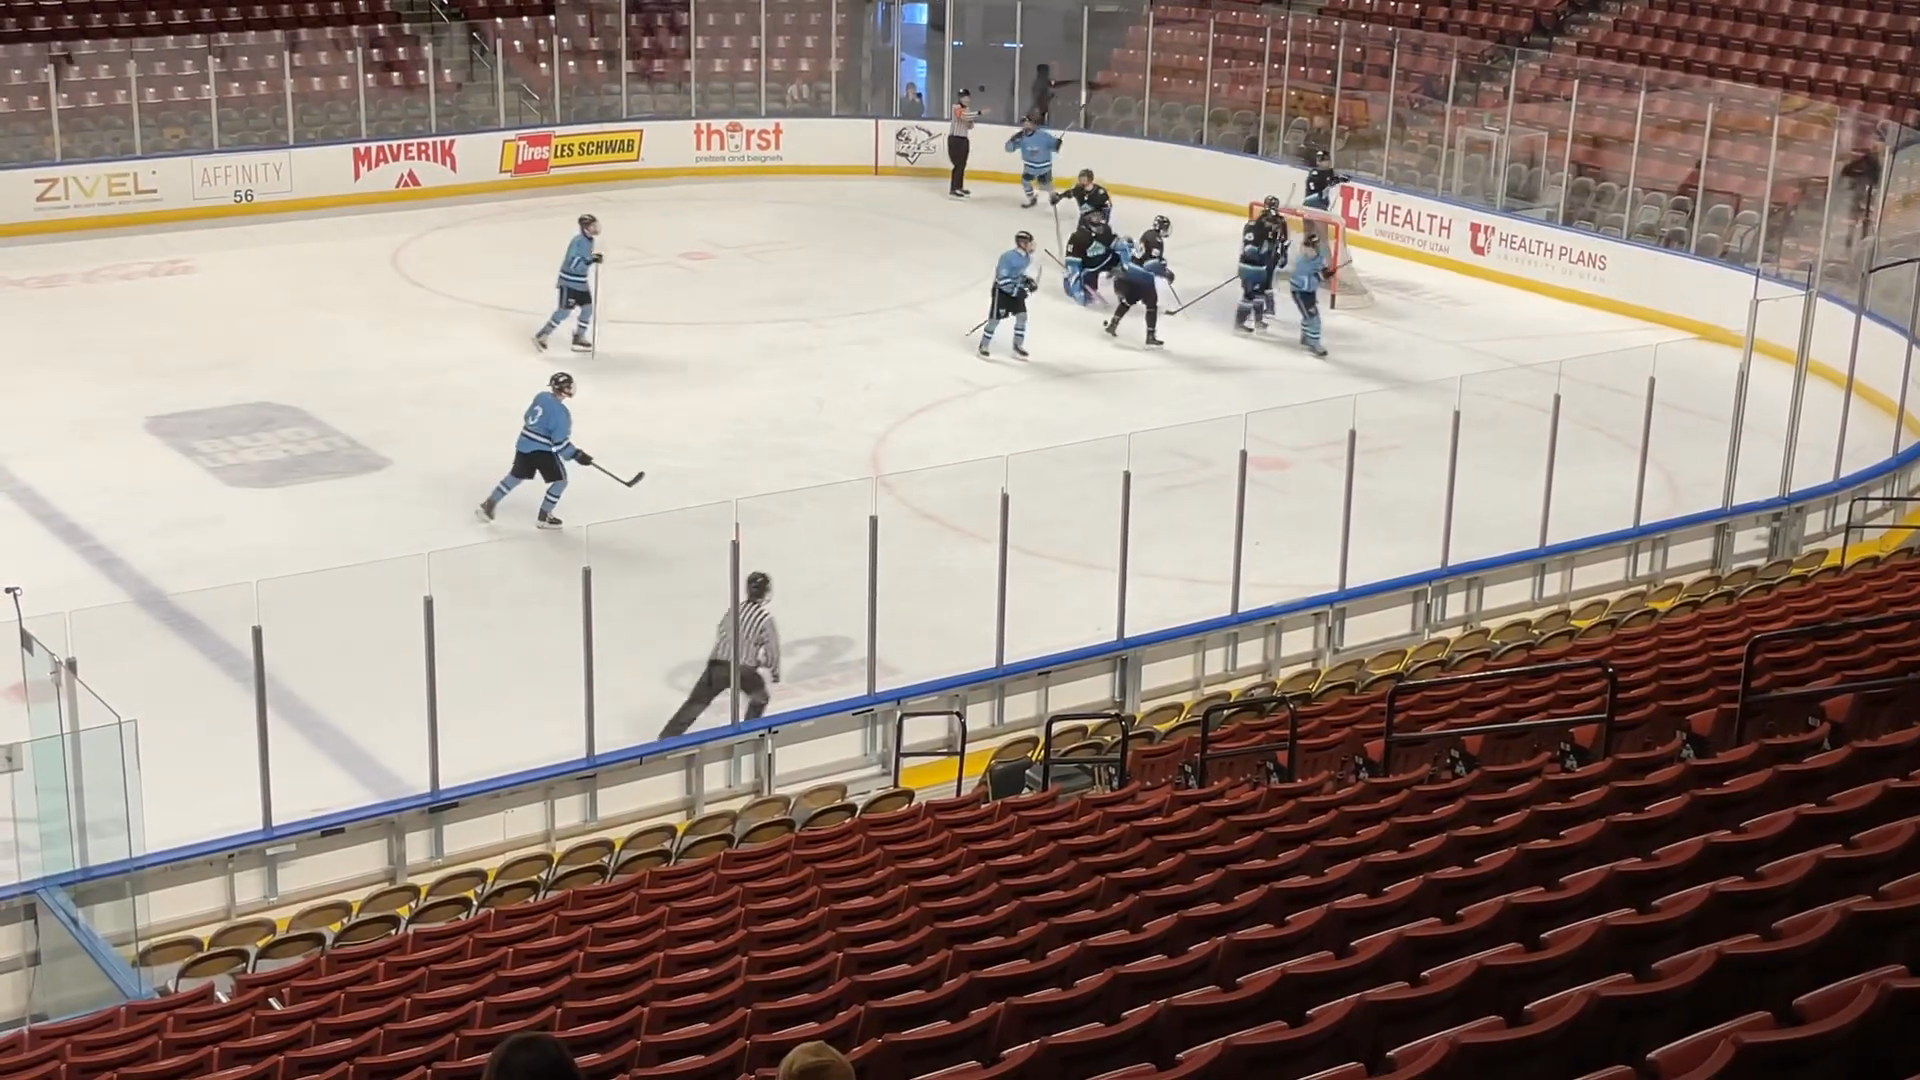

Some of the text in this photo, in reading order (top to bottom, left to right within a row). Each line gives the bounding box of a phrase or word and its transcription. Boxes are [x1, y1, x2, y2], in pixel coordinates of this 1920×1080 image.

[352, 139, 457, 183] MAVERIK
[517, 141, 549, 165] Tires
[554, 138, 635, 159] LES SCHWAB
[695, 154, 783, 163] pretzels and beignets
[34, 172, 158, 202] ZIVEL
[201, 163, 283, 188] AFFINITY
[233, 189, 254, 203] 56
[1376, 201, 1452, 240] HEALTH
[1374, 228, 1450, 255] UNIVERSITY OF UTAH
[1499, 232, 1607, 271] HEALTH PLANS
